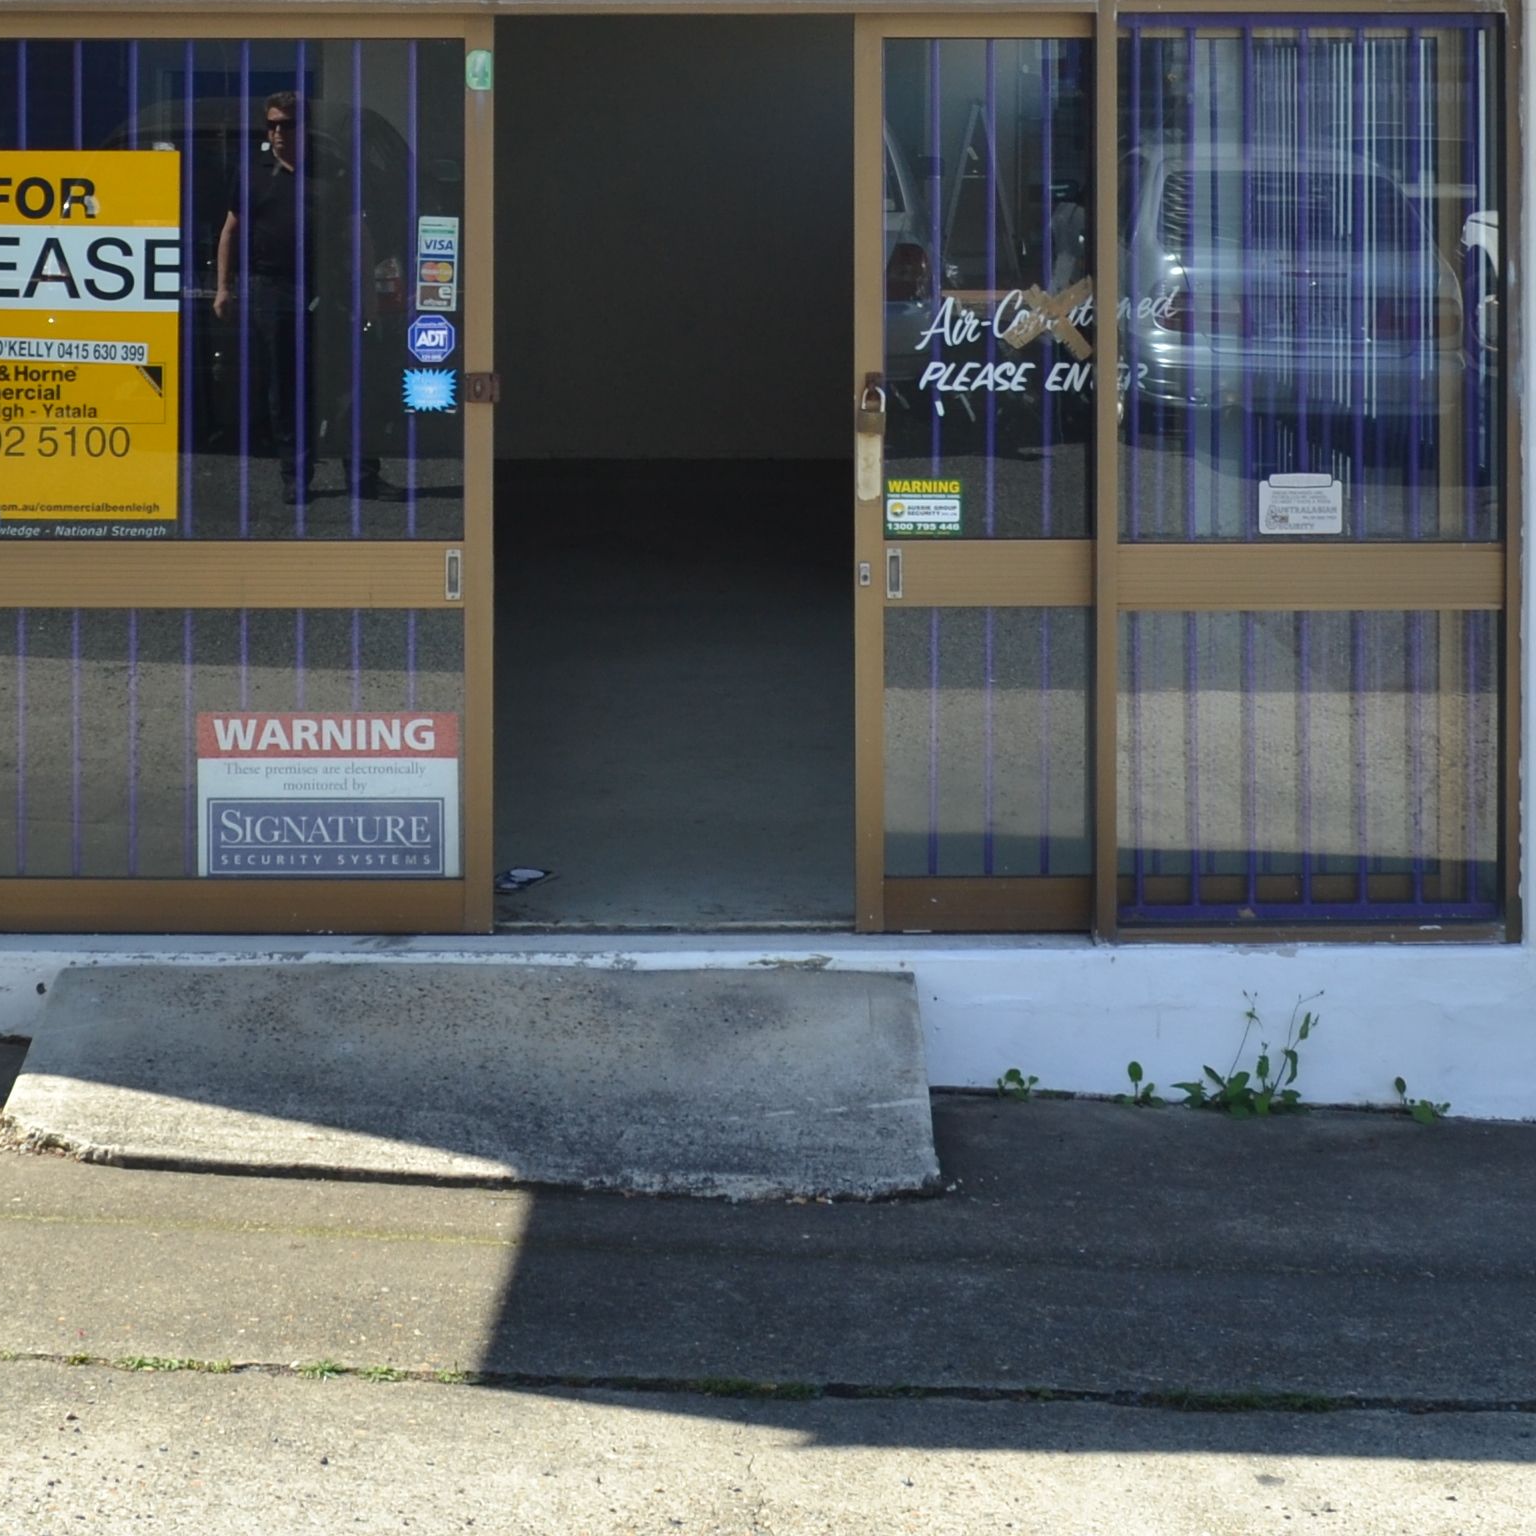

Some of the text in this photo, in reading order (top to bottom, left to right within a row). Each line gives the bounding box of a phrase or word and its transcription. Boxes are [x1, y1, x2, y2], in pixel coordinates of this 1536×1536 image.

[424, 239, 454, 251] VISA
[415, 329, 448, 347] ADT
[58, 342, 89, 360] 0415
[93, 344, 118, 361] 630
[120, 344, 145, 362] 399
[14, 365, 77, 382] Horne
[918, 361, 1036, 392] PLEASE
[42, 403, 98, 419] Yatala
[37, 426, 131, 458] 5100
[887, 480, 961, 493] WARNING
[54, 525, 107, 537] National
[111, 525, 167, 538] Strength
[213, 718, 436, 751] WARNING
[224, 762, 427, 778] These premises are electronically
[283, 778, 368, 794] monitored by
[219, 808, 432, 847] SIGNATURE
[221, 854, 432, 865] SECURITY SYSTEMS
